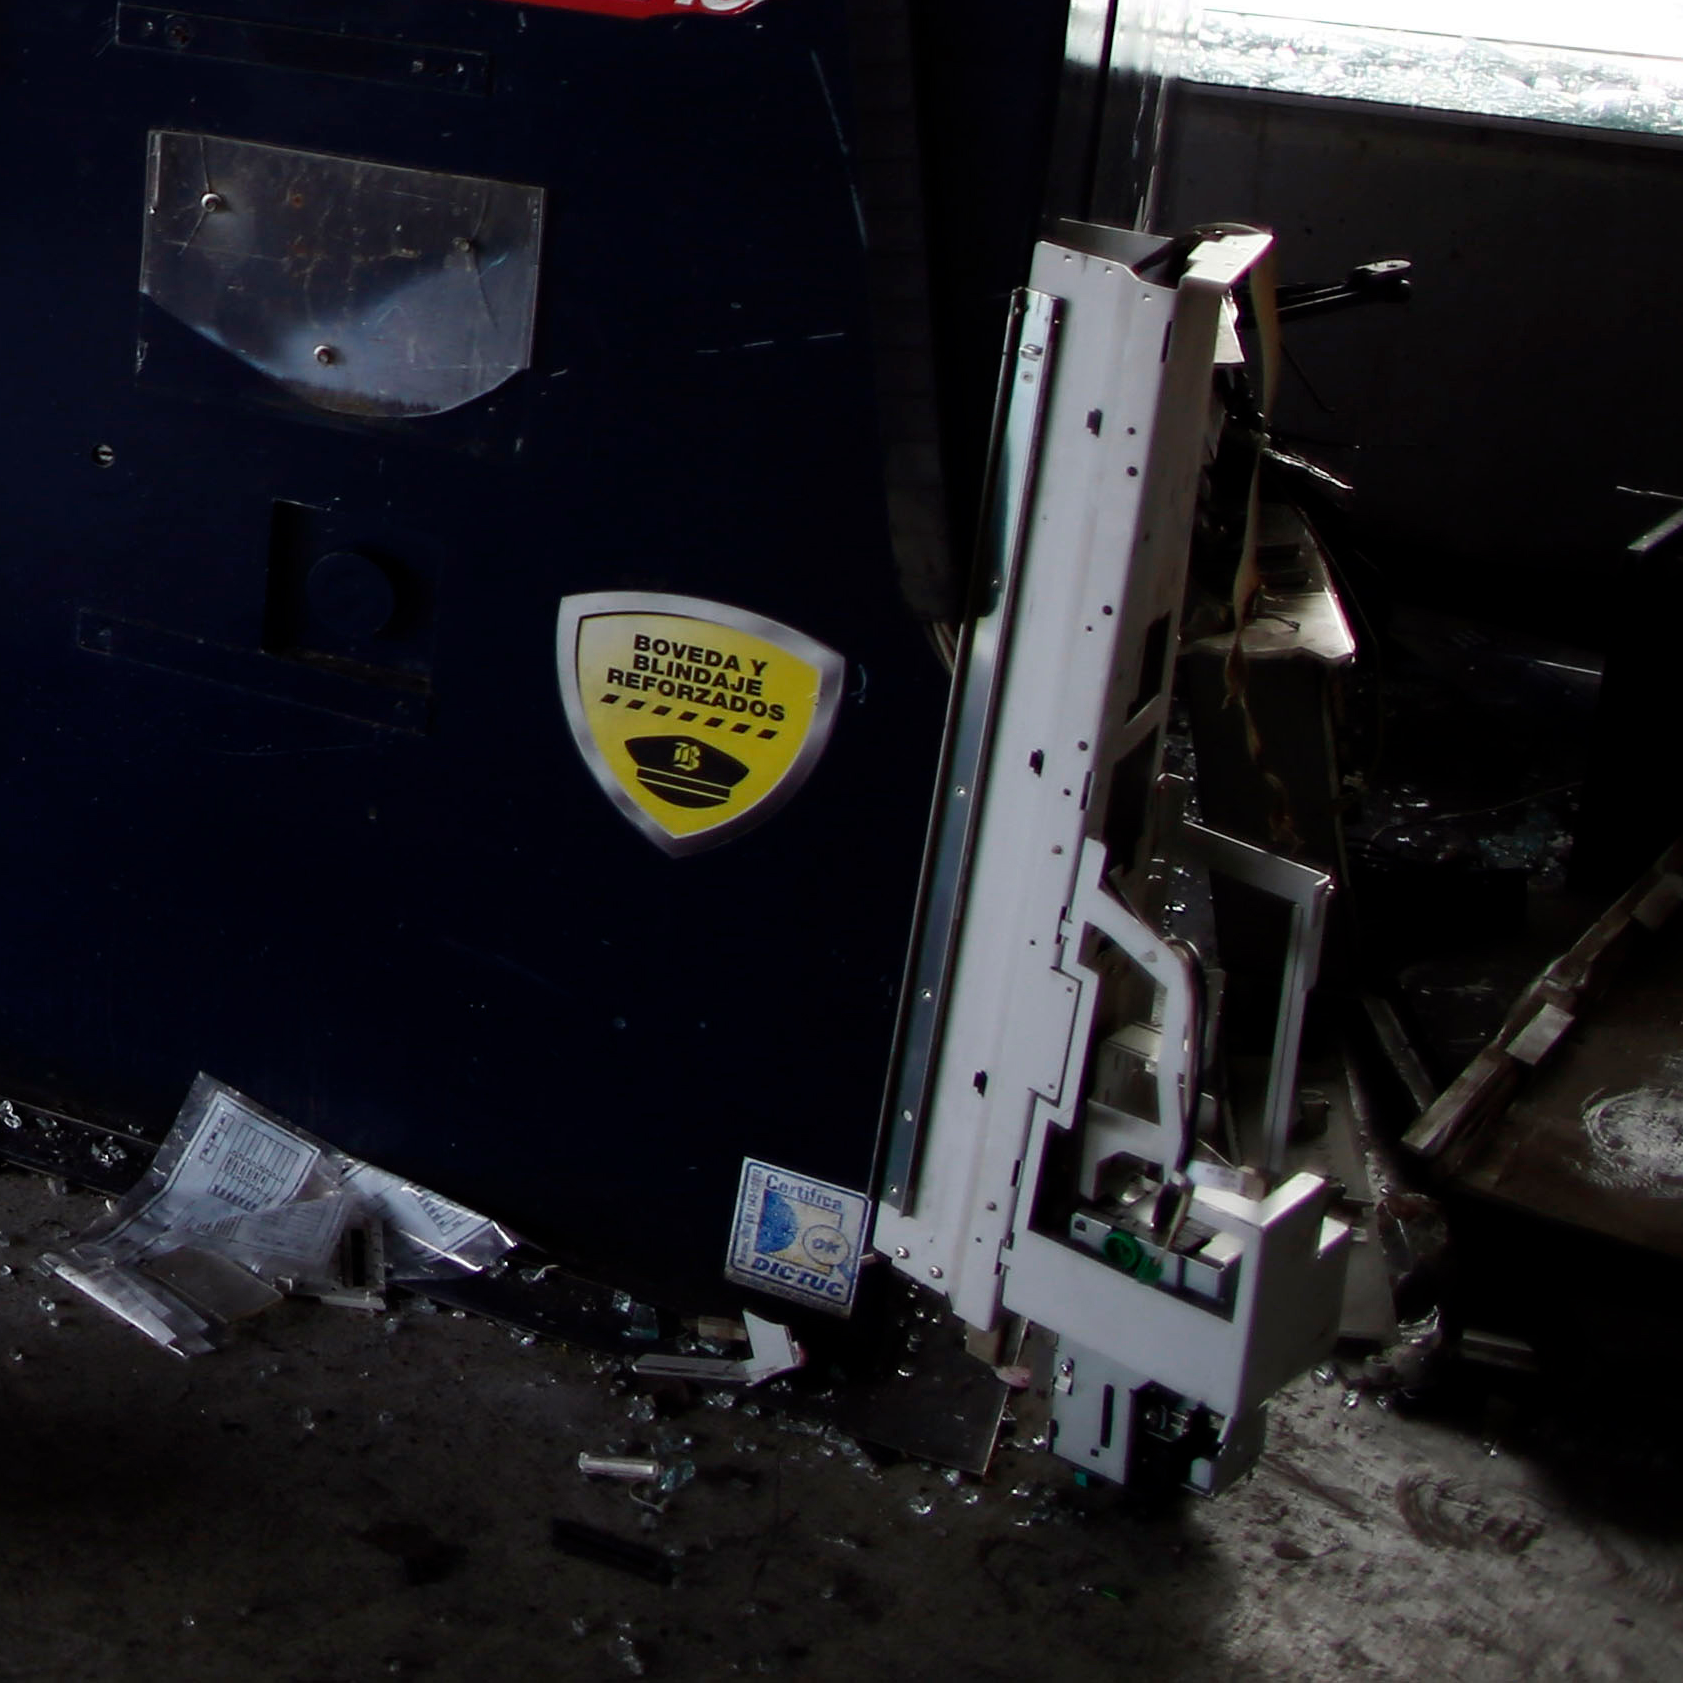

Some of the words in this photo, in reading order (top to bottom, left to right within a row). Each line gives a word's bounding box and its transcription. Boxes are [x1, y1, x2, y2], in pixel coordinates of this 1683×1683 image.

[633, 653, 763, 697] BLINDAJE
[634, 633, 741, 673] BOVEDA
[749, 658, 768, 677] Y
[606, 667, 786, 722] REFORZADOS
[765, 1172, 843, 1211] Certifica
[811, 1237, 840, 1255] OK
[751, 1256, 845, 1297] DICTUC
